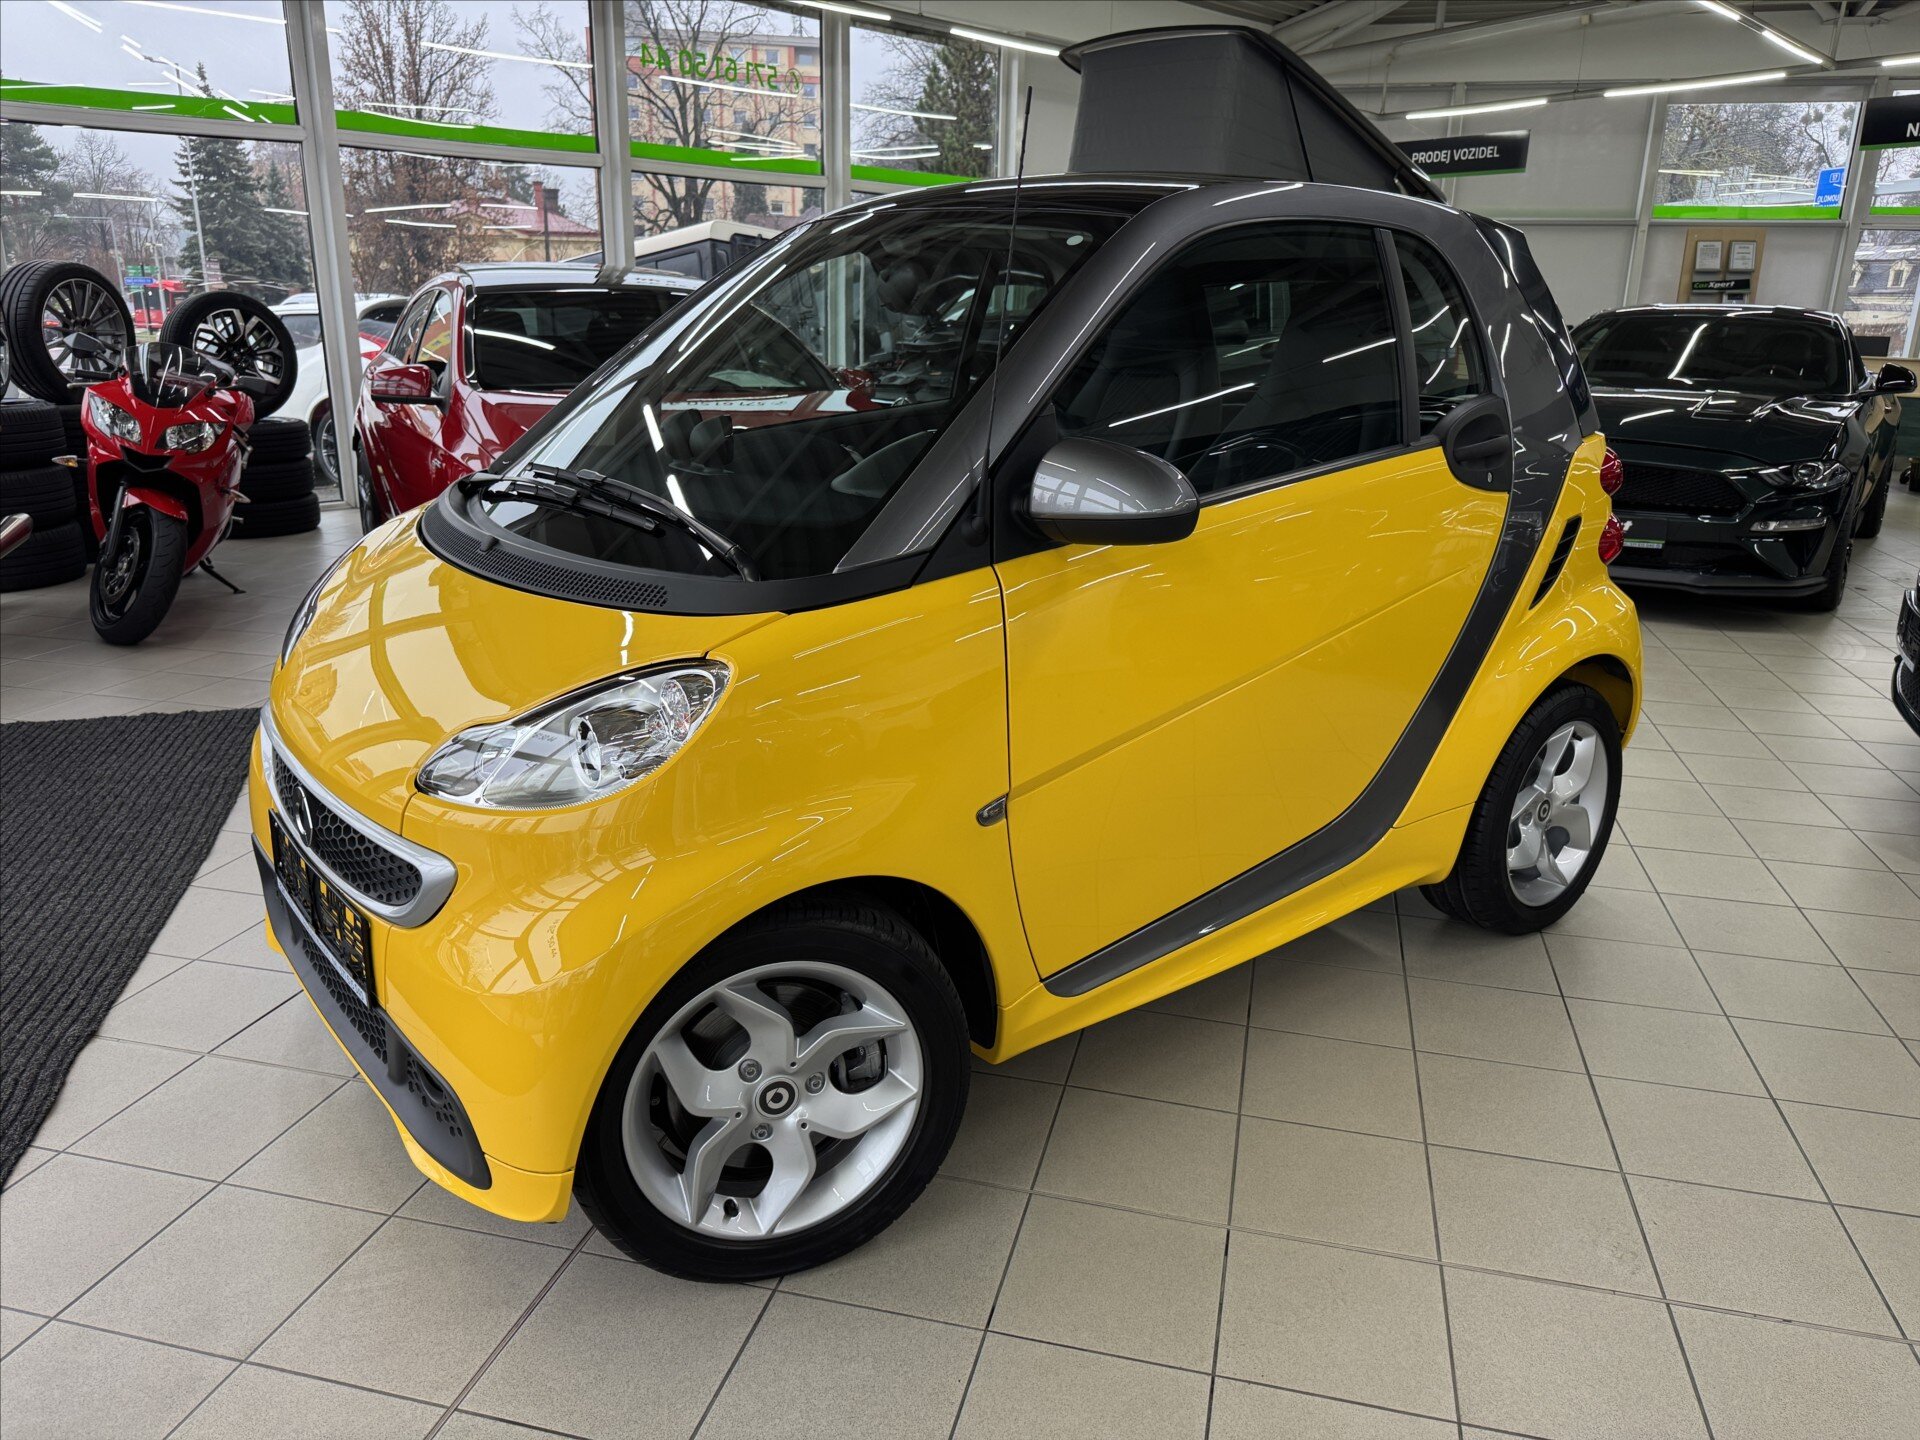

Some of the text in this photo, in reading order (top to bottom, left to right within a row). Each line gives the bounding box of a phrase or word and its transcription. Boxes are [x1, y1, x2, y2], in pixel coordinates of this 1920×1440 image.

[1906, 122, 1920, 138] N
[1412, 146, 1500, 164] PRODEJ VOZIDEL
